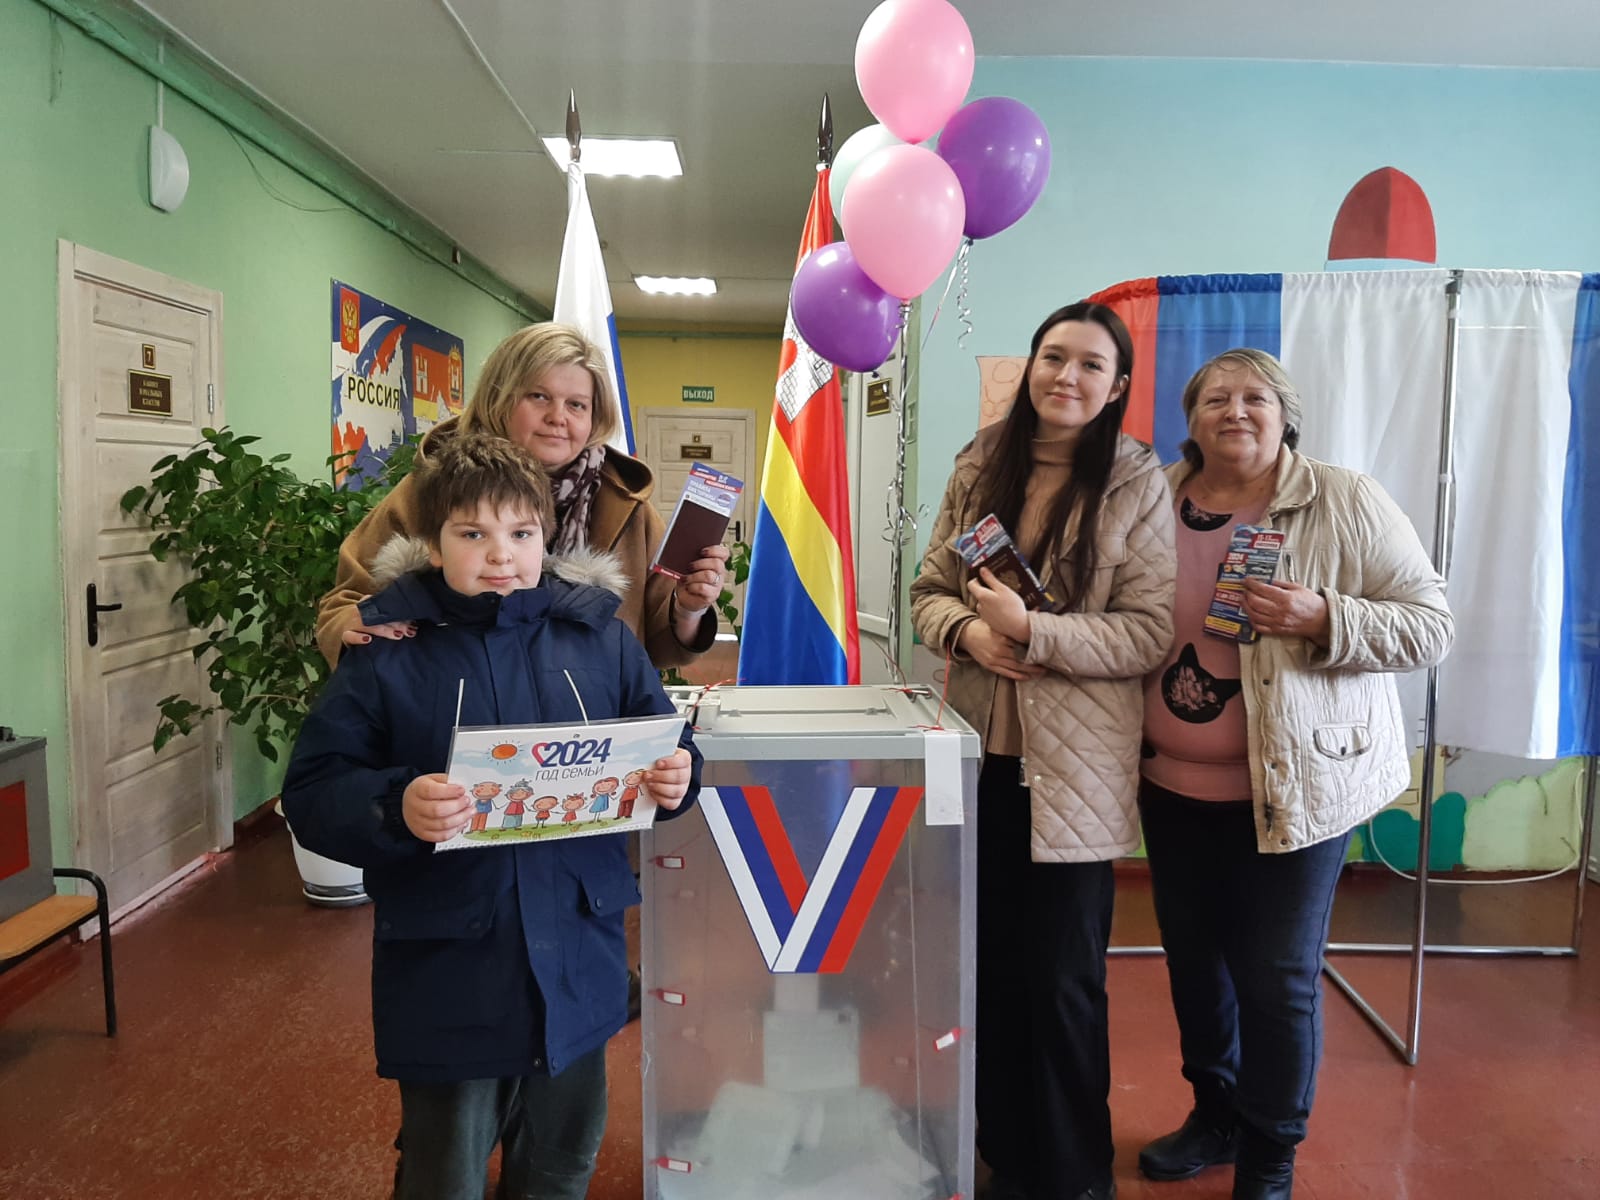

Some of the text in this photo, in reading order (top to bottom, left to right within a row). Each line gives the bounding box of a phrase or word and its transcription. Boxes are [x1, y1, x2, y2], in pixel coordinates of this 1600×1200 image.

[146, 350, 152, 362] 7
[348, 376, 400, 410] РОССИЯ
[683, 389, 713, 401] ВЫХОД
[541, 738, 612, 768] 2024
